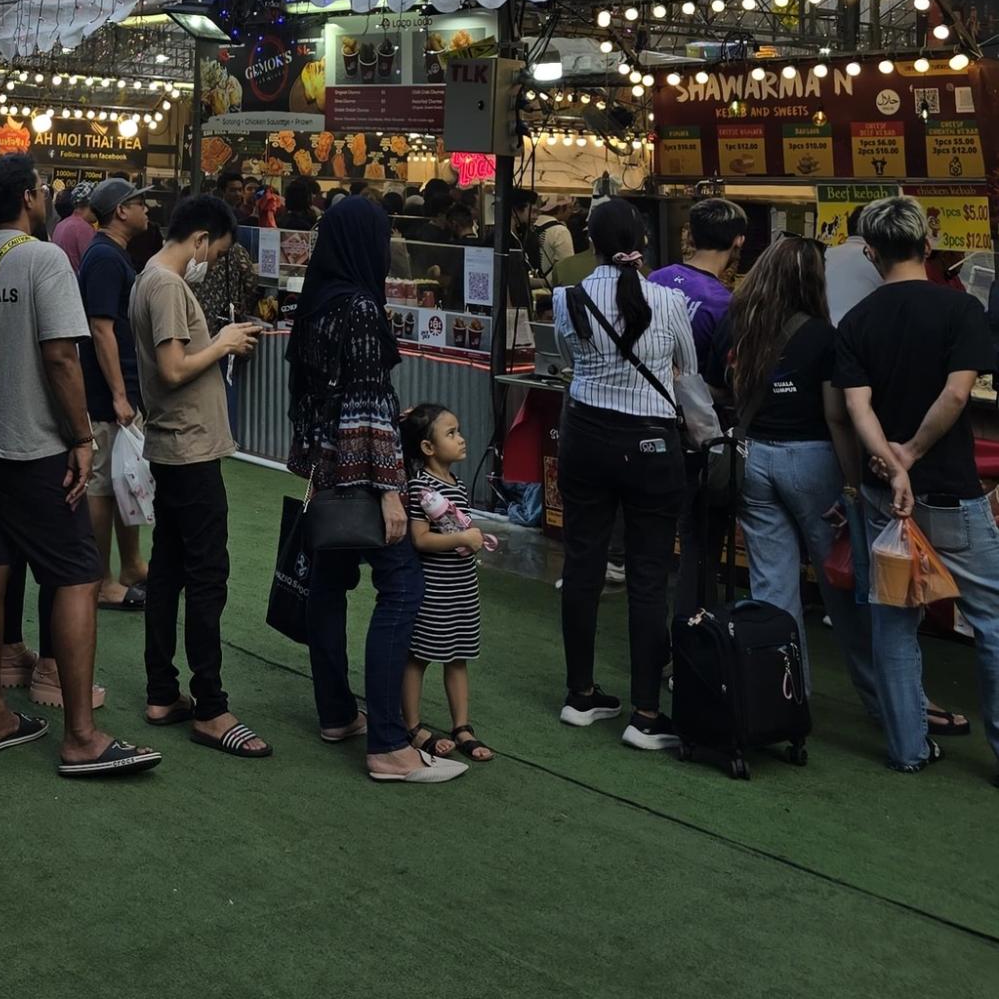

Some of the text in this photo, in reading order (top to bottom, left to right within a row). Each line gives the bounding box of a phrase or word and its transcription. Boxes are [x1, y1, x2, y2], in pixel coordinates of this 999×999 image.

[451, 63, 489, 84] TLK
[750, 106, 770, 118] AND
[772, 105, 809, 117] SWEETS
[34, 132, 53, 145] AH
[56, 133, 81, 147] MOI
[116, 136, 142, 150] TEA
[940, 204, 988, 221] 1pcs $5.00
[943, 233, 992, 249] 3pcs $12.00
[772, 386, 798, 394] LUMPUR
